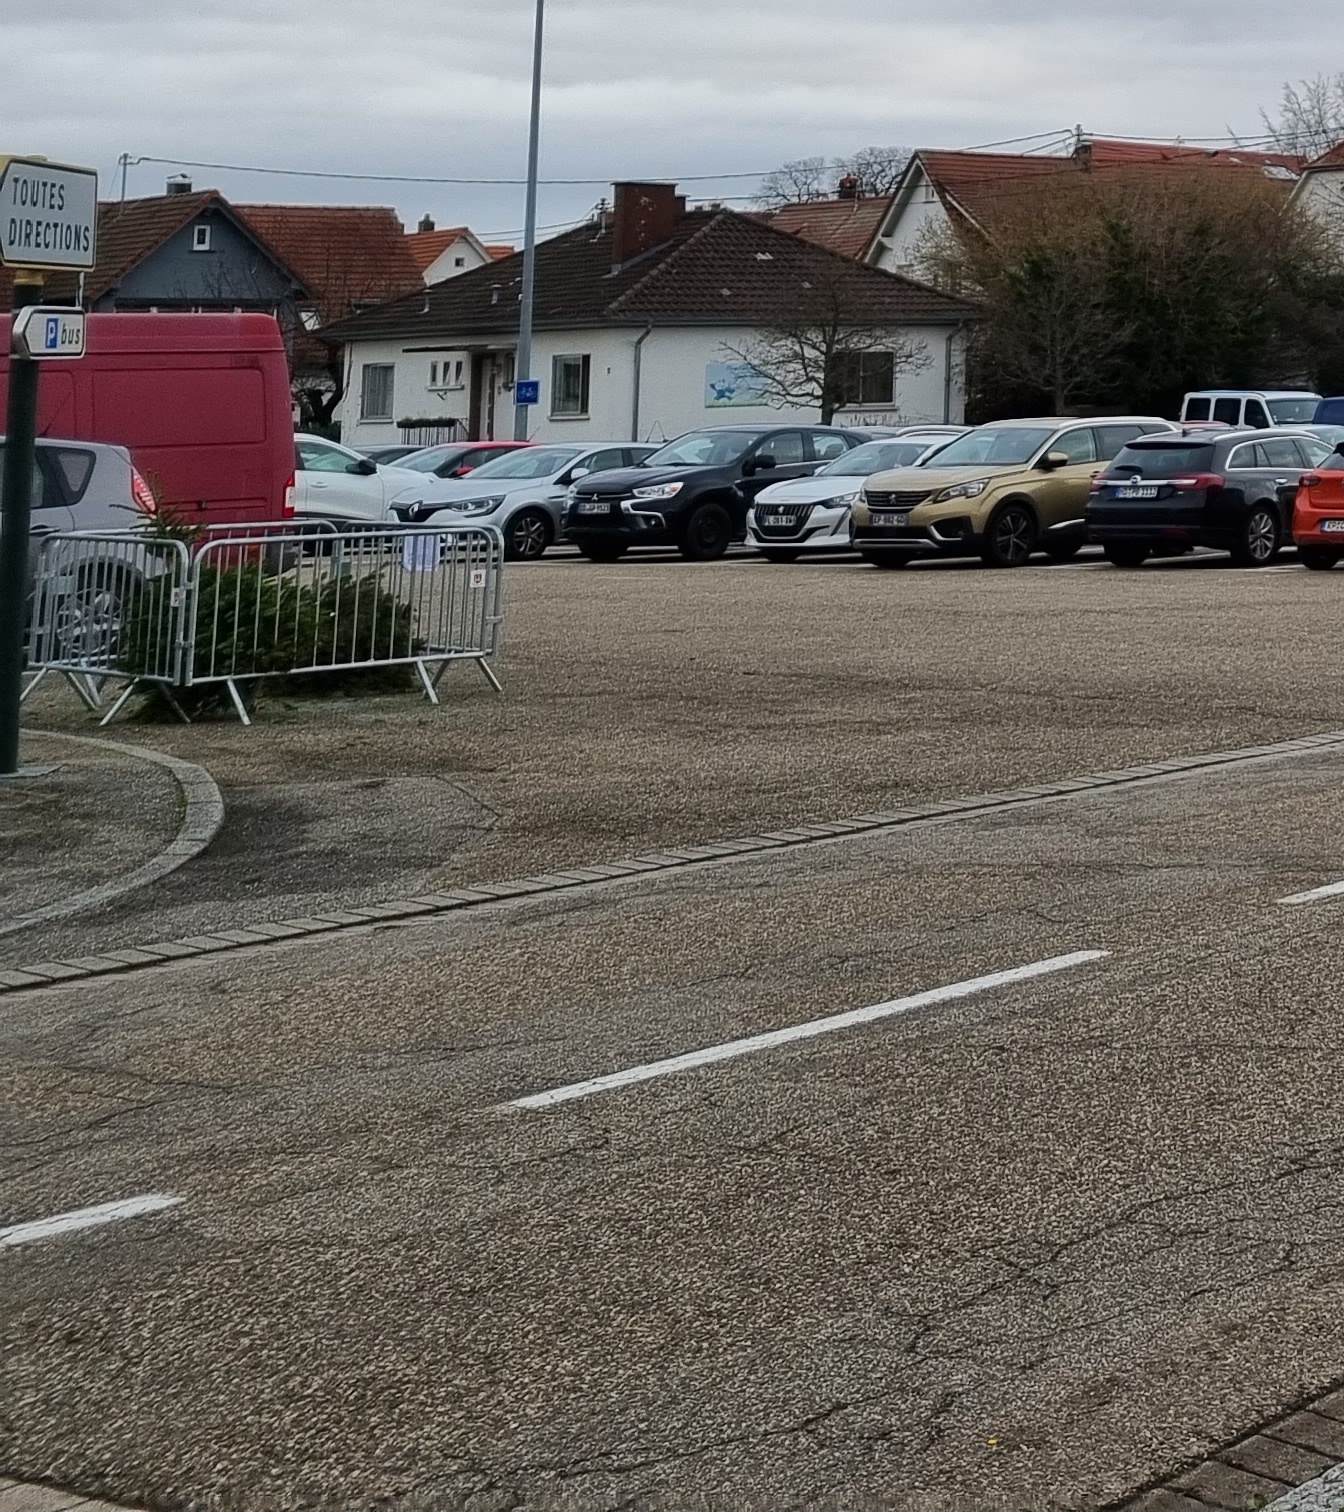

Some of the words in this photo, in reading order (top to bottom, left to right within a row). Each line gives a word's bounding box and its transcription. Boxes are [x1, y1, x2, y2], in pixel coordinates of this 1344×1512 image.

[13, 176, 65, 211] TOUTES
[8, 217, 90, 253] DIRECTIONS
[46, 321, 57, 347] P
[61, 322, 81, 345] bus
